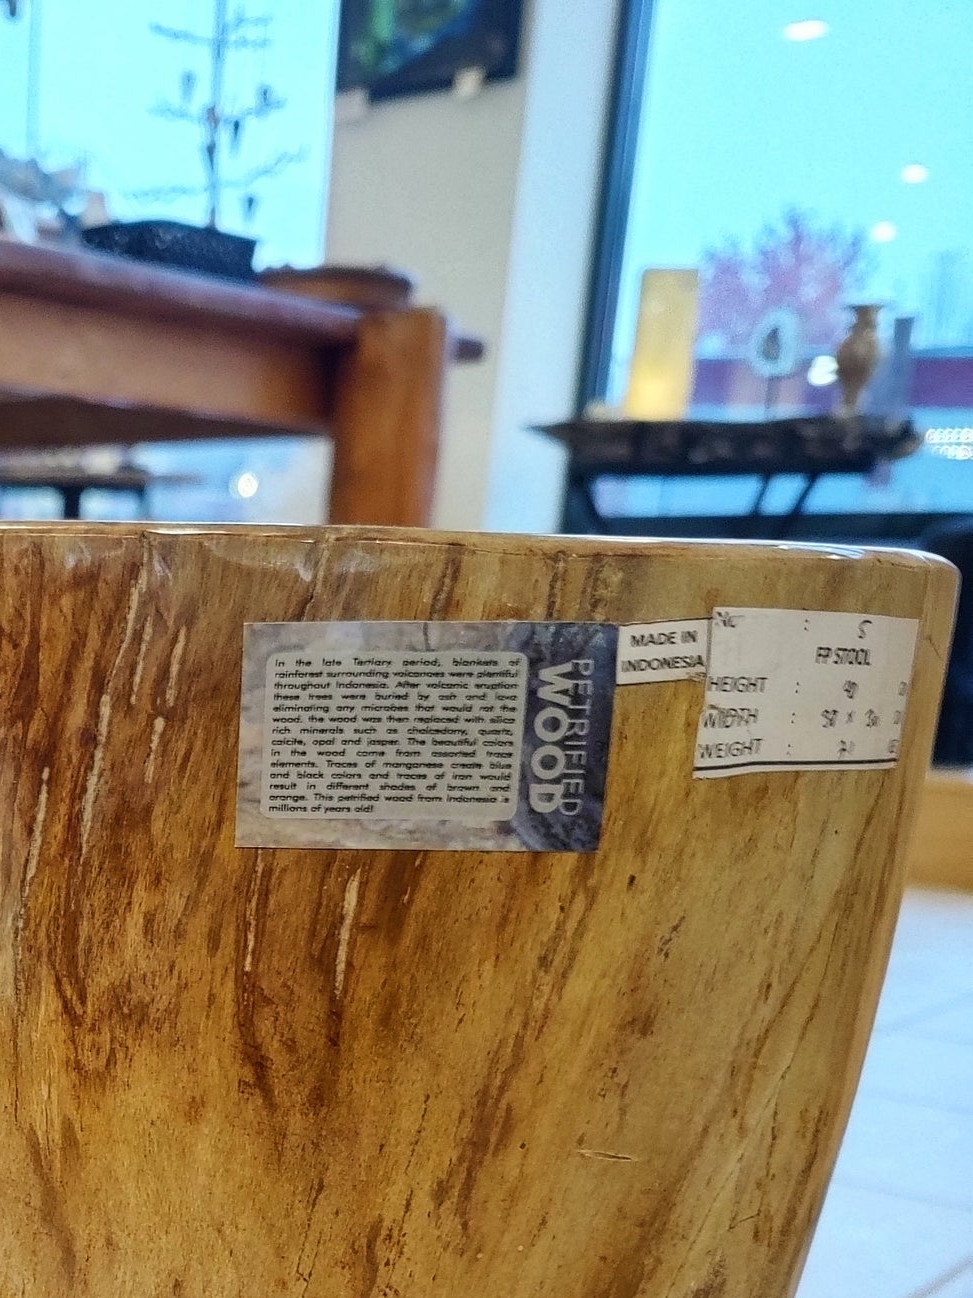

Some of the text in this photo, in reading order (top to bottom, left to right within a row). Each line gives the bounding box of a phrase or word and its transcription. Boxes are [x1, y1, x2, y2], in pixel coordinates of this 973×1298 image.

[630, 630, 698, 648] MADE IN
[275, 659, 285, 667] In
[296, 658, 312, 667] the
[322, 657, 342, 667] late
[353, 657, 391, 668] Tertiary
[508, 658, 521, 666] of
[621, 655, 706, 673] INDONESIA
[275, 670, 323, 678] rainforest
[326, 670, 389, 679] surrounding
[392, 670, 444, 678] volcanoes
[274, 681, 331, 691] throughout
[336, 681, 389, 689] Indonesia.
[427, 681, 468, 689] volcanic
[707, 676, 768, 693] HEIGHT
[273, 692, 300, 700] these
[308, 692, 332, 700] trees
[375, 692, 408, 700] buried
[418, 692, 429, 702] by
[438, 692, 456, 700] ash
[465, 692, 486, 700] and
[272, 704, 329, 713] eliminating
[336, 705, 355, 713] any
[361, 703, 408, 711] microbes
[415, 703, 434, 712] that
[441, 703, 472, 712] would
[328, 715, 357, 723] wood
[387, 715, 409, 723] then
[414, 715, 459, 725] replaced
[464, 715, 484, 723] with
[272, 726, 290, 734] rich
[300, 726, 344, 734] minerals
[353, 726, 377, 734] such
[312, 737, 335, 747] opal
[341, 737, 361, 745] and
[407, 737, 426, 746] The
[432, 737, 476, 746] beautiful
[529, 659, 595, 816] PETRIFIED WOOD
[271, 748, 280, 757] in
[291, 748, 306, 757] the
[317, 748, 346, 757] wood
[396, 748, 421, 757] from
[431, 749, 476, 757] assorted
[698, 738, 764, 758] WEIGHT
[326, 760, 358, 768] Traces
[365, 760, 376, 768] of
[382, 762, 443, 770] manganese
[270, 771, 290, 779] and
[297, 771, 324, 779] black
[331, 771, 361, 779] colors
[369, 771, 389, 779] and
[452, 772, 473, 780] iron
[479, 772, 511, 780] would
[270, 782, 297, 790] result
[307, 782, 316, 790] in
[327, 782, 369, 790] different
[379, 782, 415, 790] shades
[447, 783, 480, 791] brown
[489, 784, 511, 792] and
[314, 793, 333, 801] This
[338, 793, 380, 802] petrified
[384, 794, 413, 802] wood
[418, 794, 442, 802] from
[447, 794, 497, 803] Indonesia
[268, 804, 307, 812] millions
[311, 804, 322, 812] of
[324, 805, 351, 814] years
